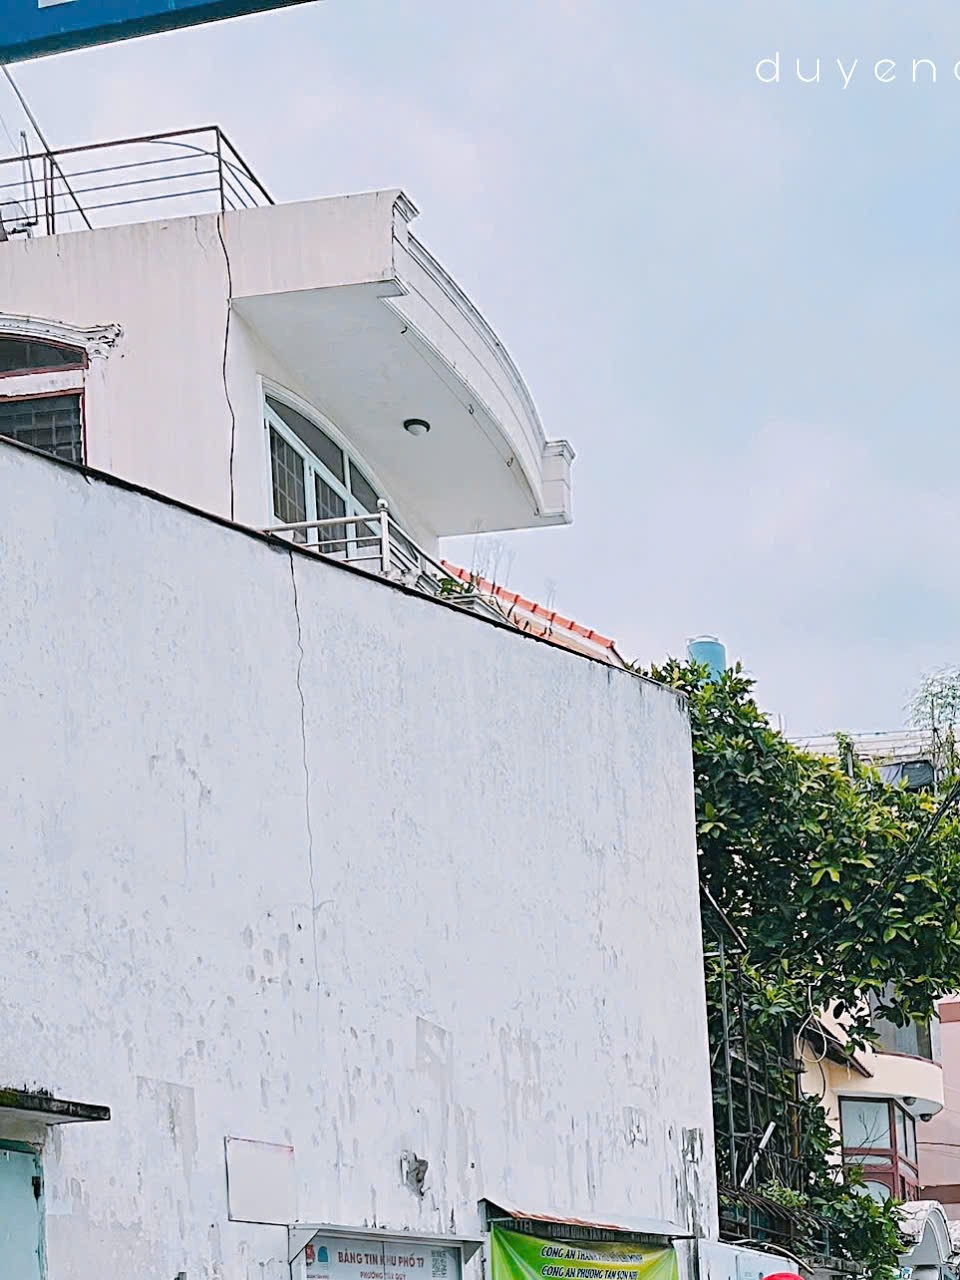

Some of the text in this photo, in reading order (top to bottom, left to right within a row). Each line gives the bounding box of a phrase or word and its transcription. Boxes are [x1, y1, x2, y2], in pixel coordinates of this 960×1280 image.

[338, 1248, 363, 1265] BẢNG
[364, 1254, 379, 1266] TIN
[398, 1253, 417, 1268] PHỐ
